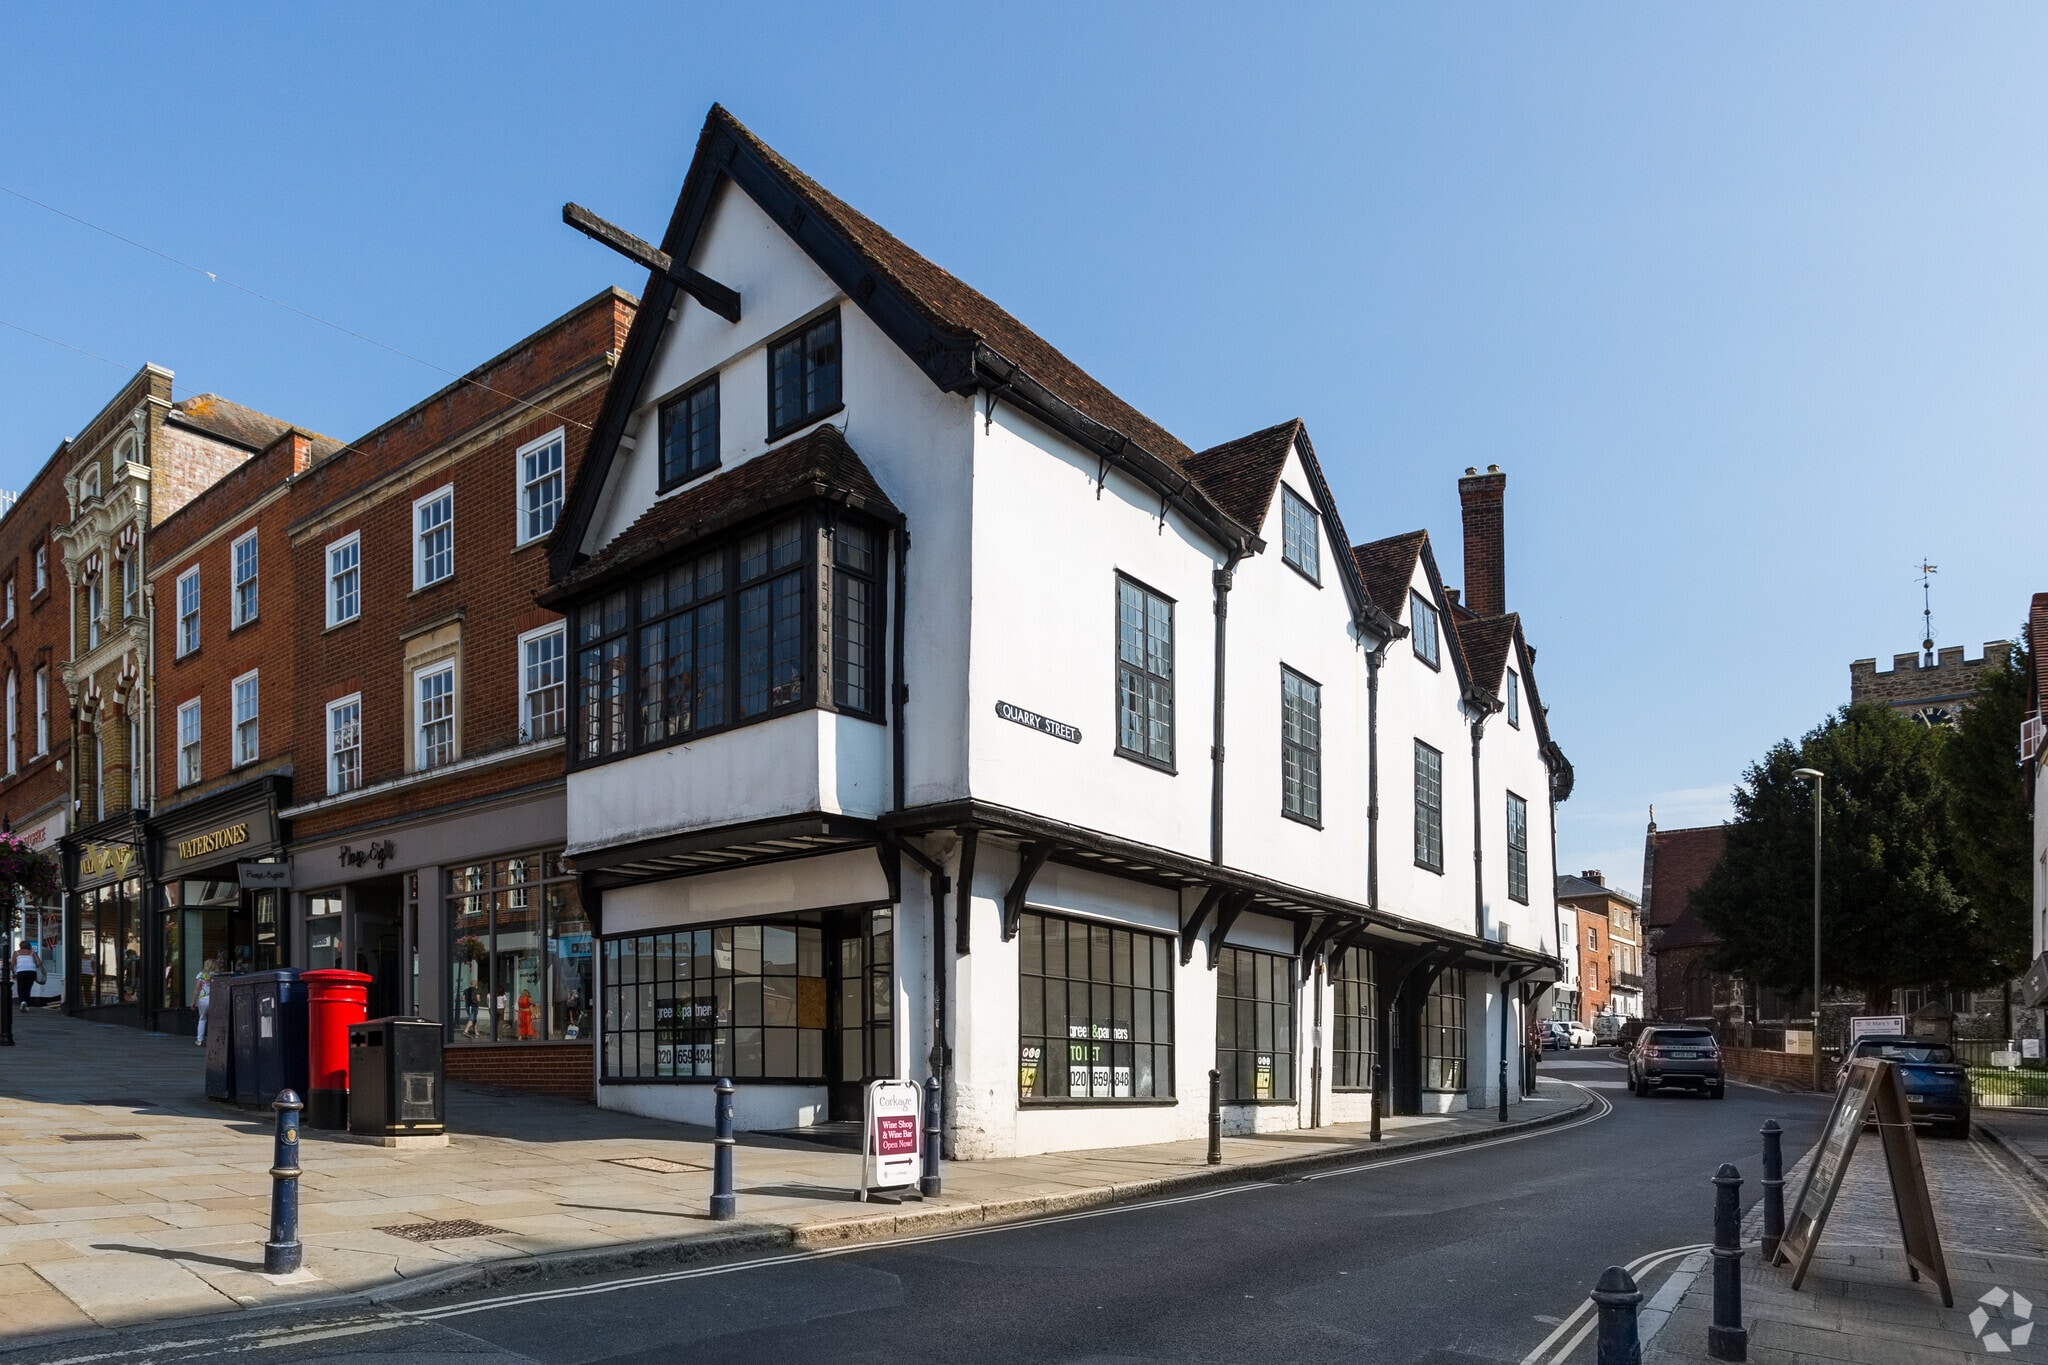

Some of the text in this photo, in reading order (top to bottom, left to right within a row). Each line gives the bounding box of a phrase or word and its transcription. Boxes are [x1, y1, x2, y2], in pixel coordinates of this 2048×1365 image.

[1002, 704, 1076, 740] QUARRY STREET
[178, 823, 246, 859] WATERSTONES
[669, 1025, 684, 1040] LT
[676, 1049, 693, 1064] 659
[695, 1049, 712, 1064] 484
[1070, 1045, 1082, 1061] TO
[1070, 1071, 1129, 1087] 020 659 848
[879, 1094, 912, 1112] Corkage
[882, 1119, 913, 1130] Wine Shop
[882, 1129, 913, 1139] & Wine Bar
[882, 1139, 913, 1150] Open Now!
